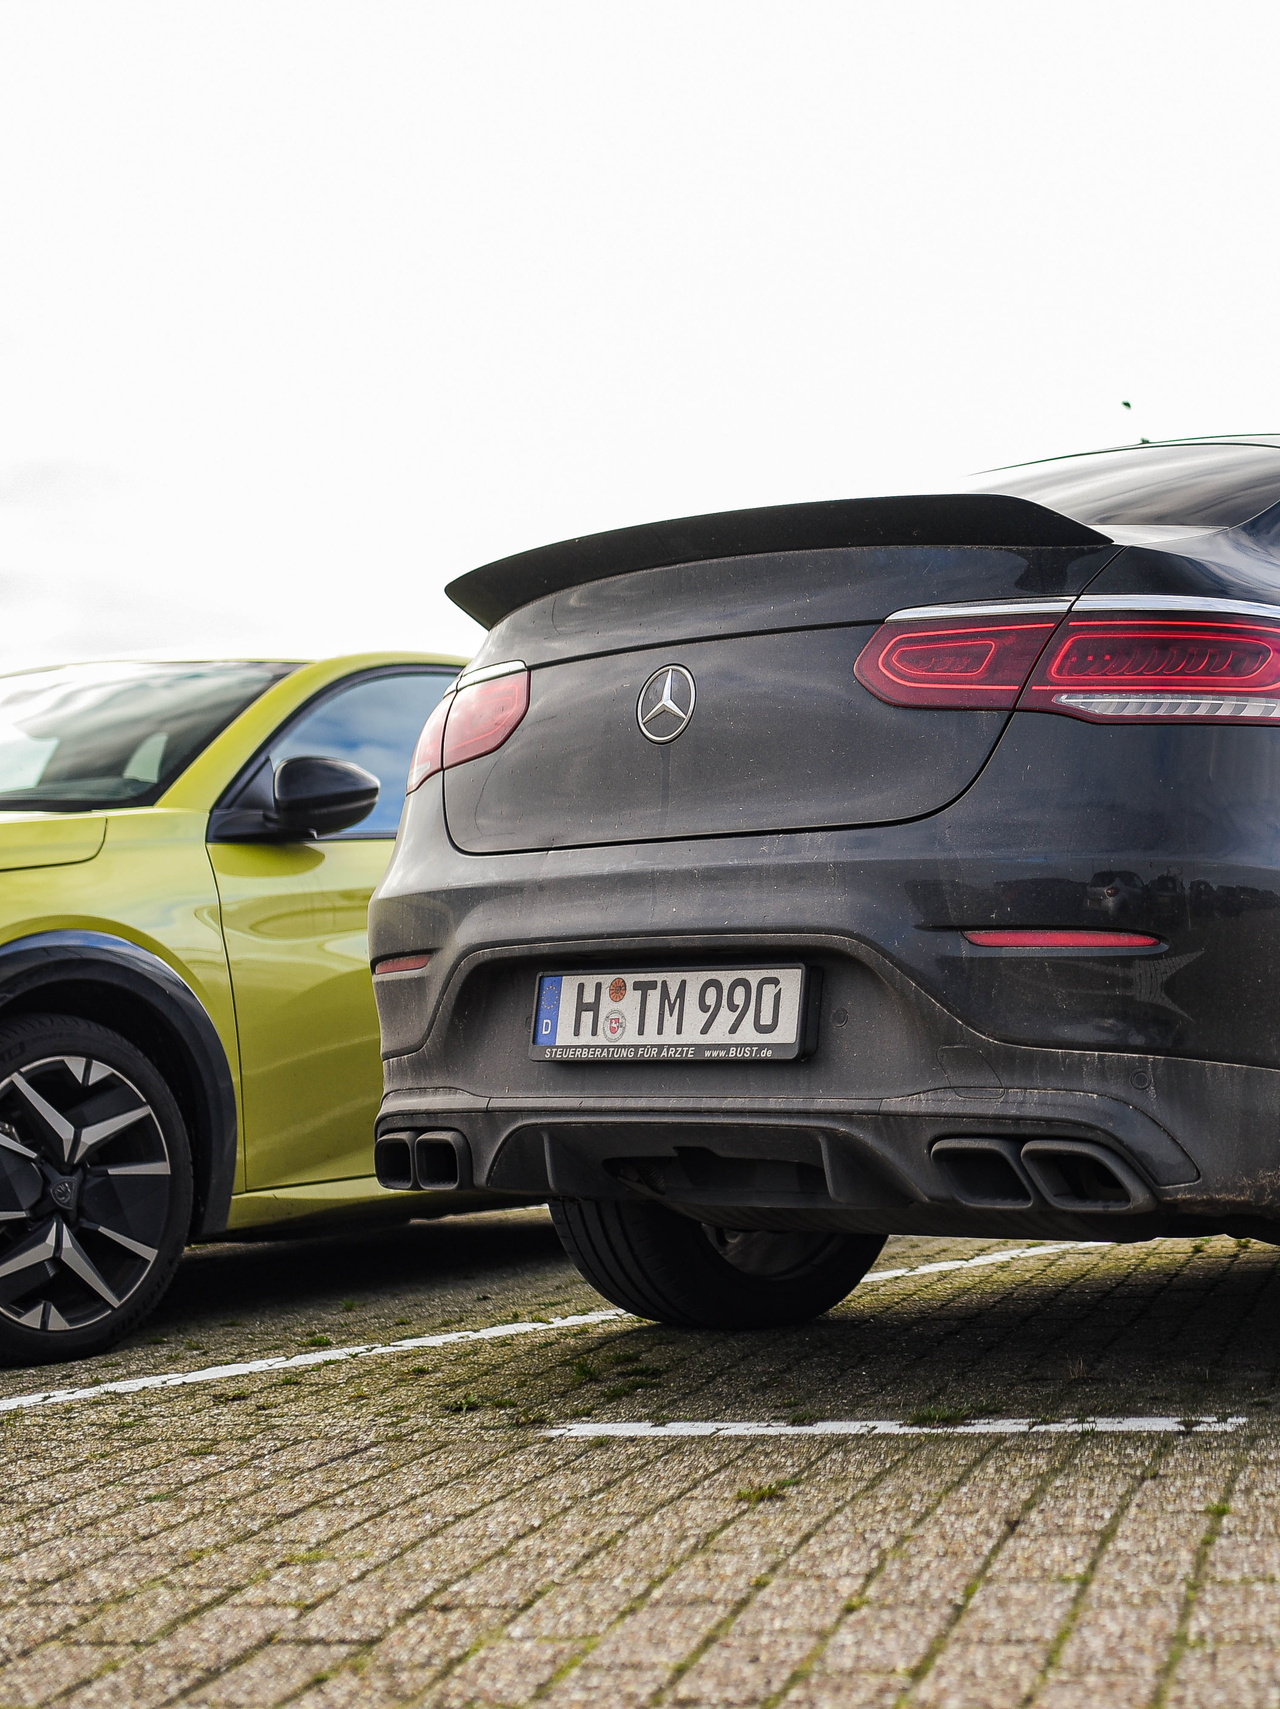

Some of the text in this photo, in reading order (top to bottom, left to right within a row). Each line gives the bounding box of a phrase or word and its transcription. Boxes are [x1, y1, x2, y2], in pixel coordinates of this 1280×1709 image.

[573, 977, 782, 1037] H TM 990
[542, 1019, 552, 1035] D
[544, 1044, 773, 1059] STEUERBERATUNG FÜR ÄRZTE www.BUST.de
